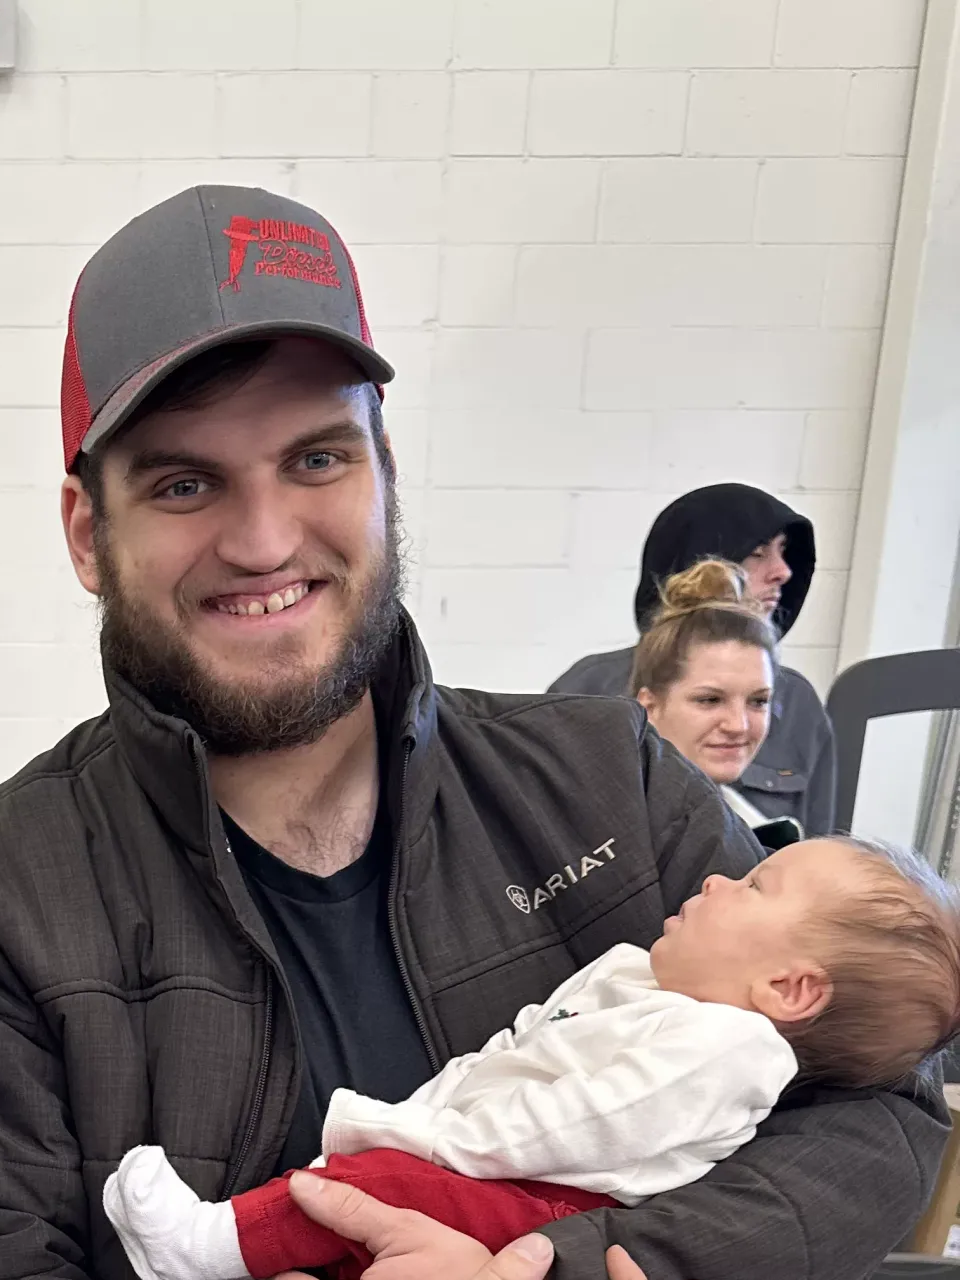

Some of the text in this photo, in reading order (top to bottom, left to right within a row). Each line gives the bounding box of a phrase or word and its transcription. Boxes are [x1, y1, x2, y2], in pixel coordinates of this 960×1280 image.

[259, 219, 330, 251] UNLIMITED
[254, 261, 342, 289] Performance
[534, 838, 616, 910] ARIAT
